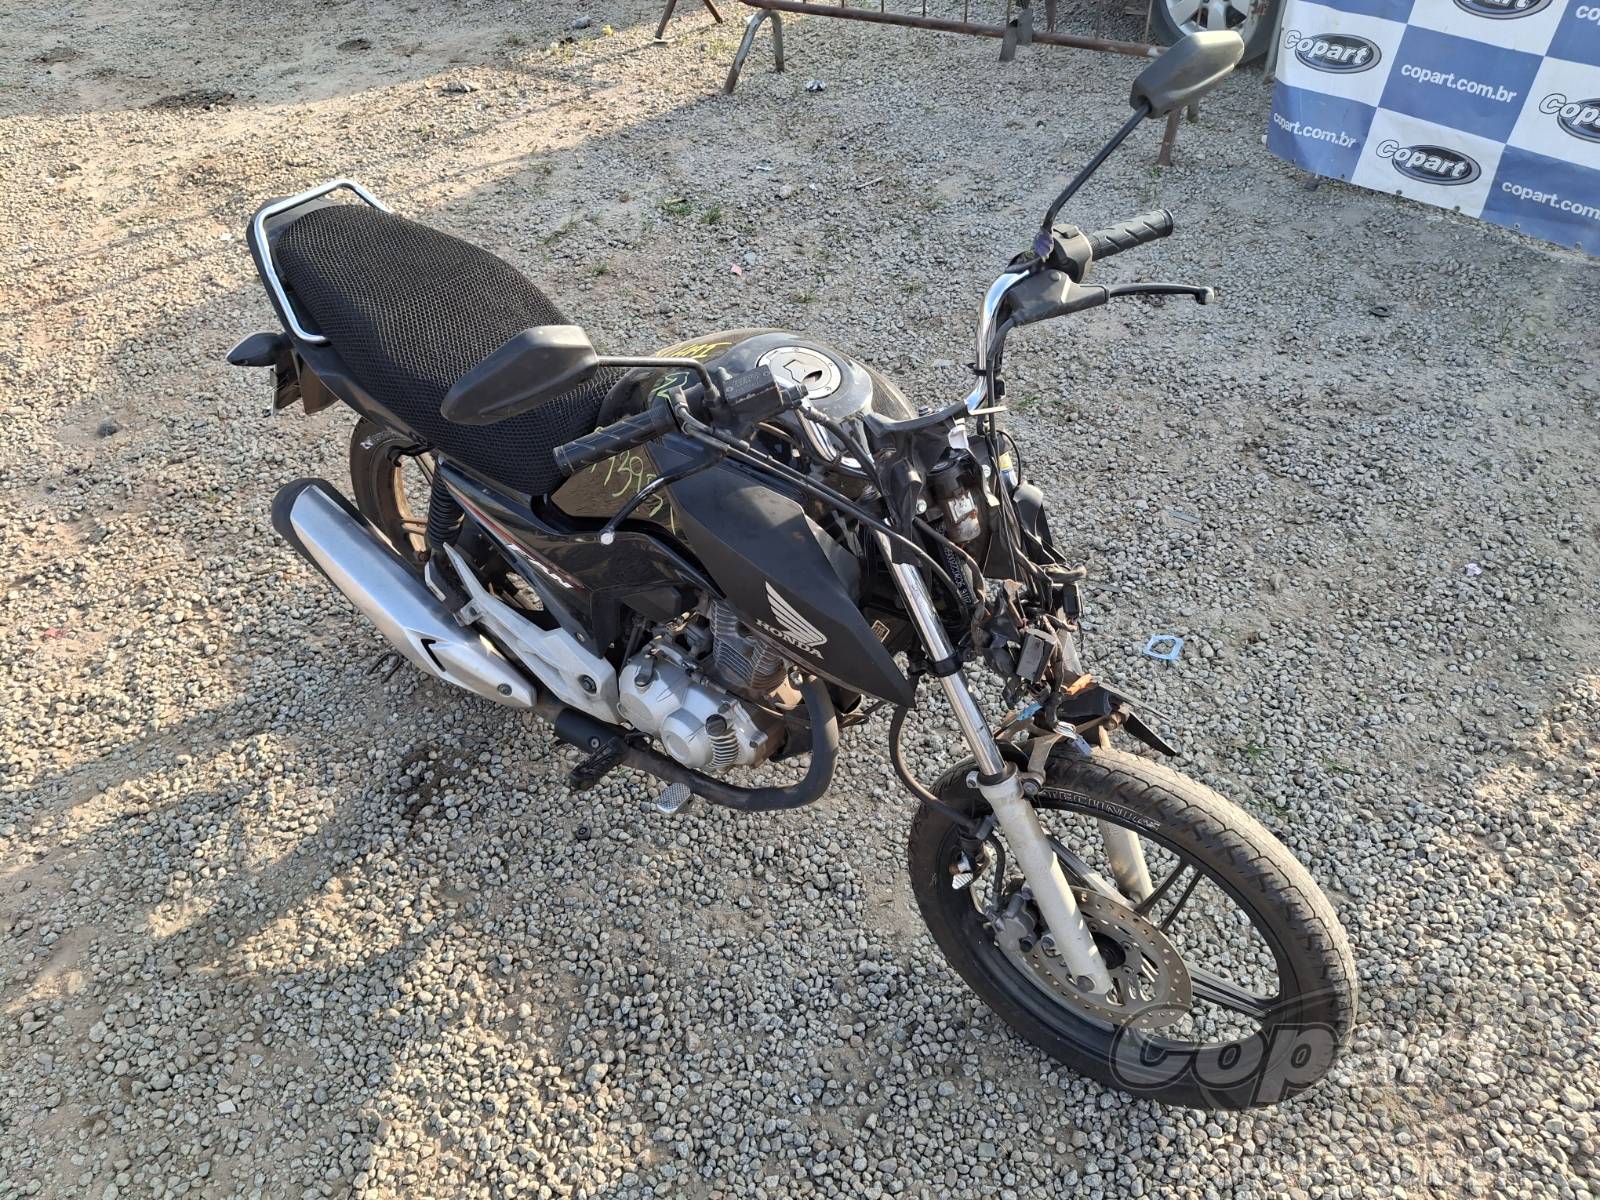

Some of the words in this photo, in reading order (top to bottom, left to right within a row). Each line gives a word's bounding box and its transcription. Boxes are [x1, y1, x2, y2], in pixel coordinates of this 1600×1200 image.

[1285, 29, 1370, 64] Copart
[1401, 64, 1517, 103] copart.com.br
[1539, 93, 1600, 127] Cop
[1273, 112, 1357, 148] copart.com.br
[1376, 139, 1467, 178] Copart
[756, 618, 825, 660] HONDA
